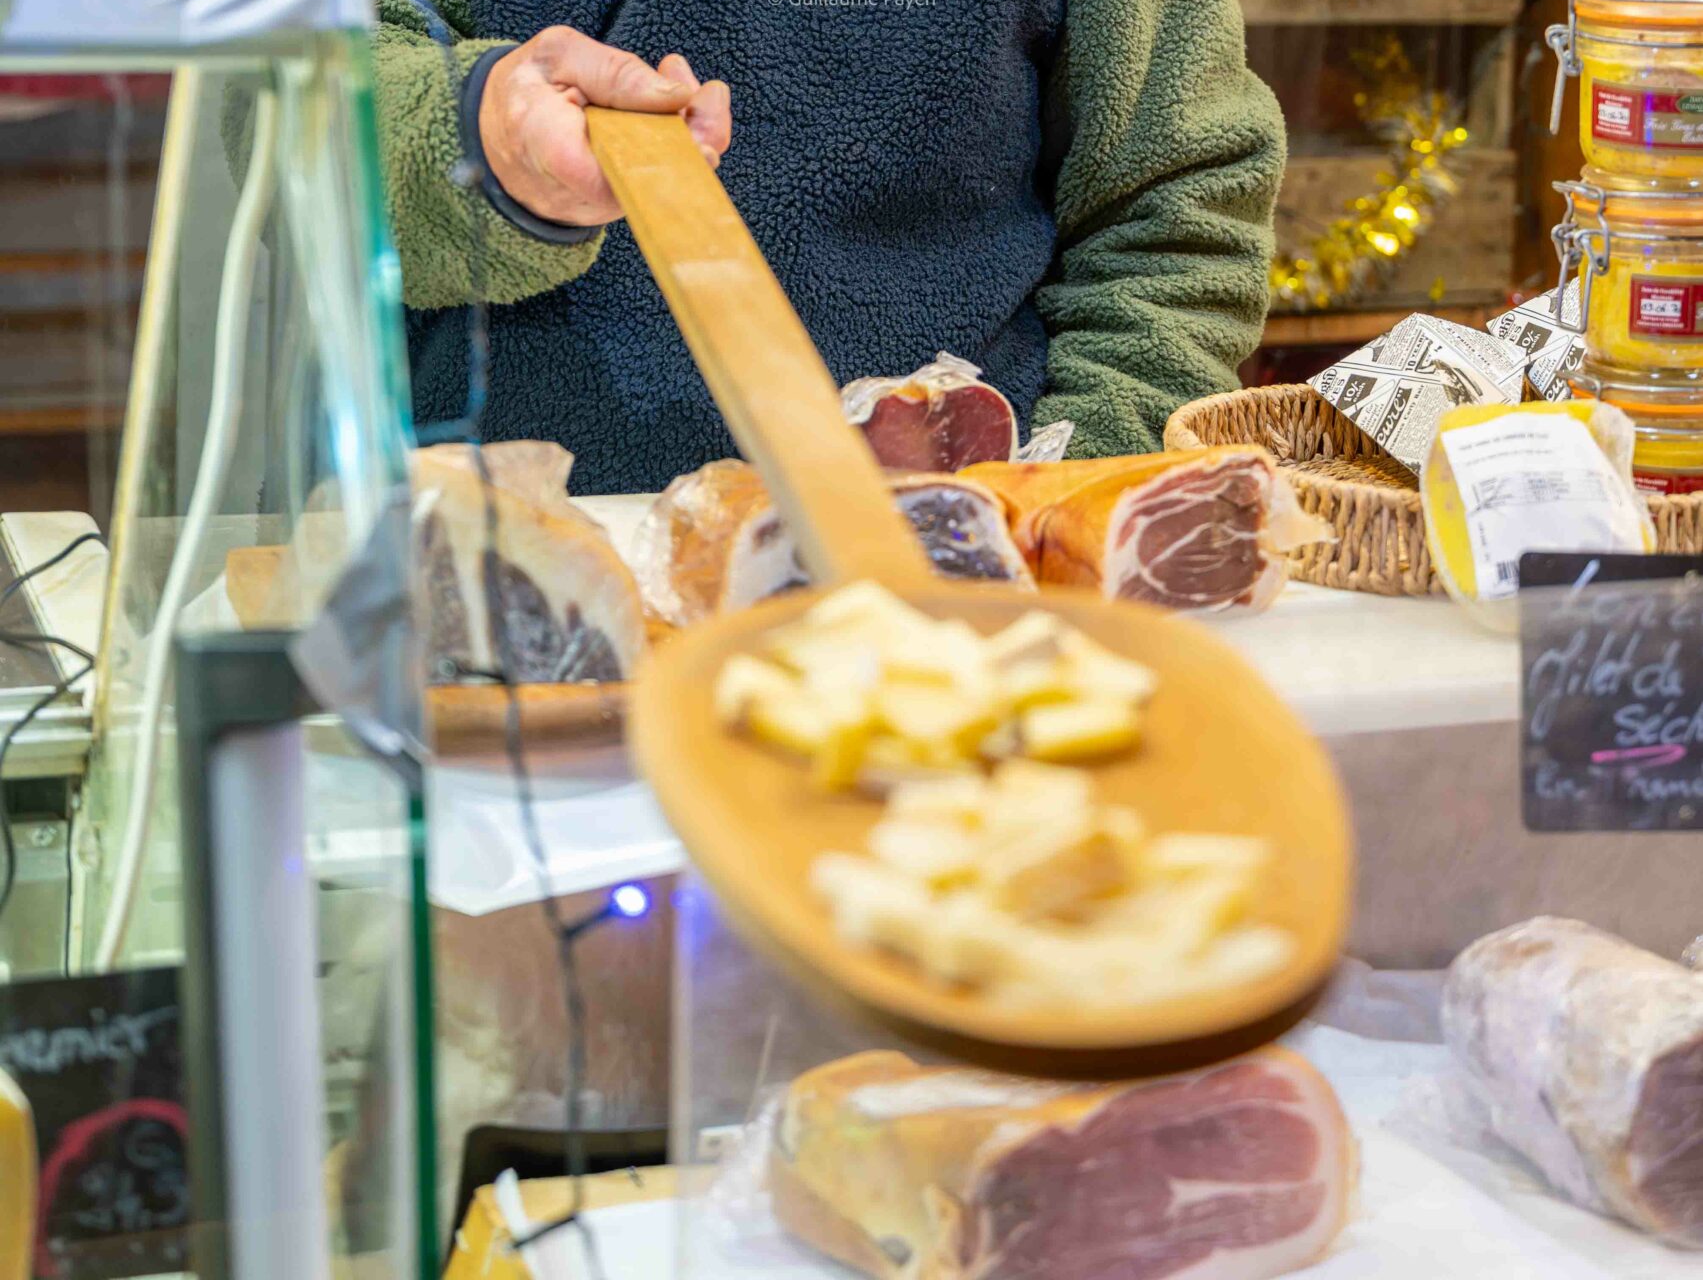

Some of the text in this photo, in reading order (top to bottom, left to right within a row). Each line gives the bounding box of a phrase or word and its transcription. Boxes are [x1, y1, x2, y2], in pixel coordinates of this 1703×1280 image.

[1404, 360, 1416, 372] 10
[1343, 380, 1359, 403] 10/-
[1353, 381, 1367, 403] each
